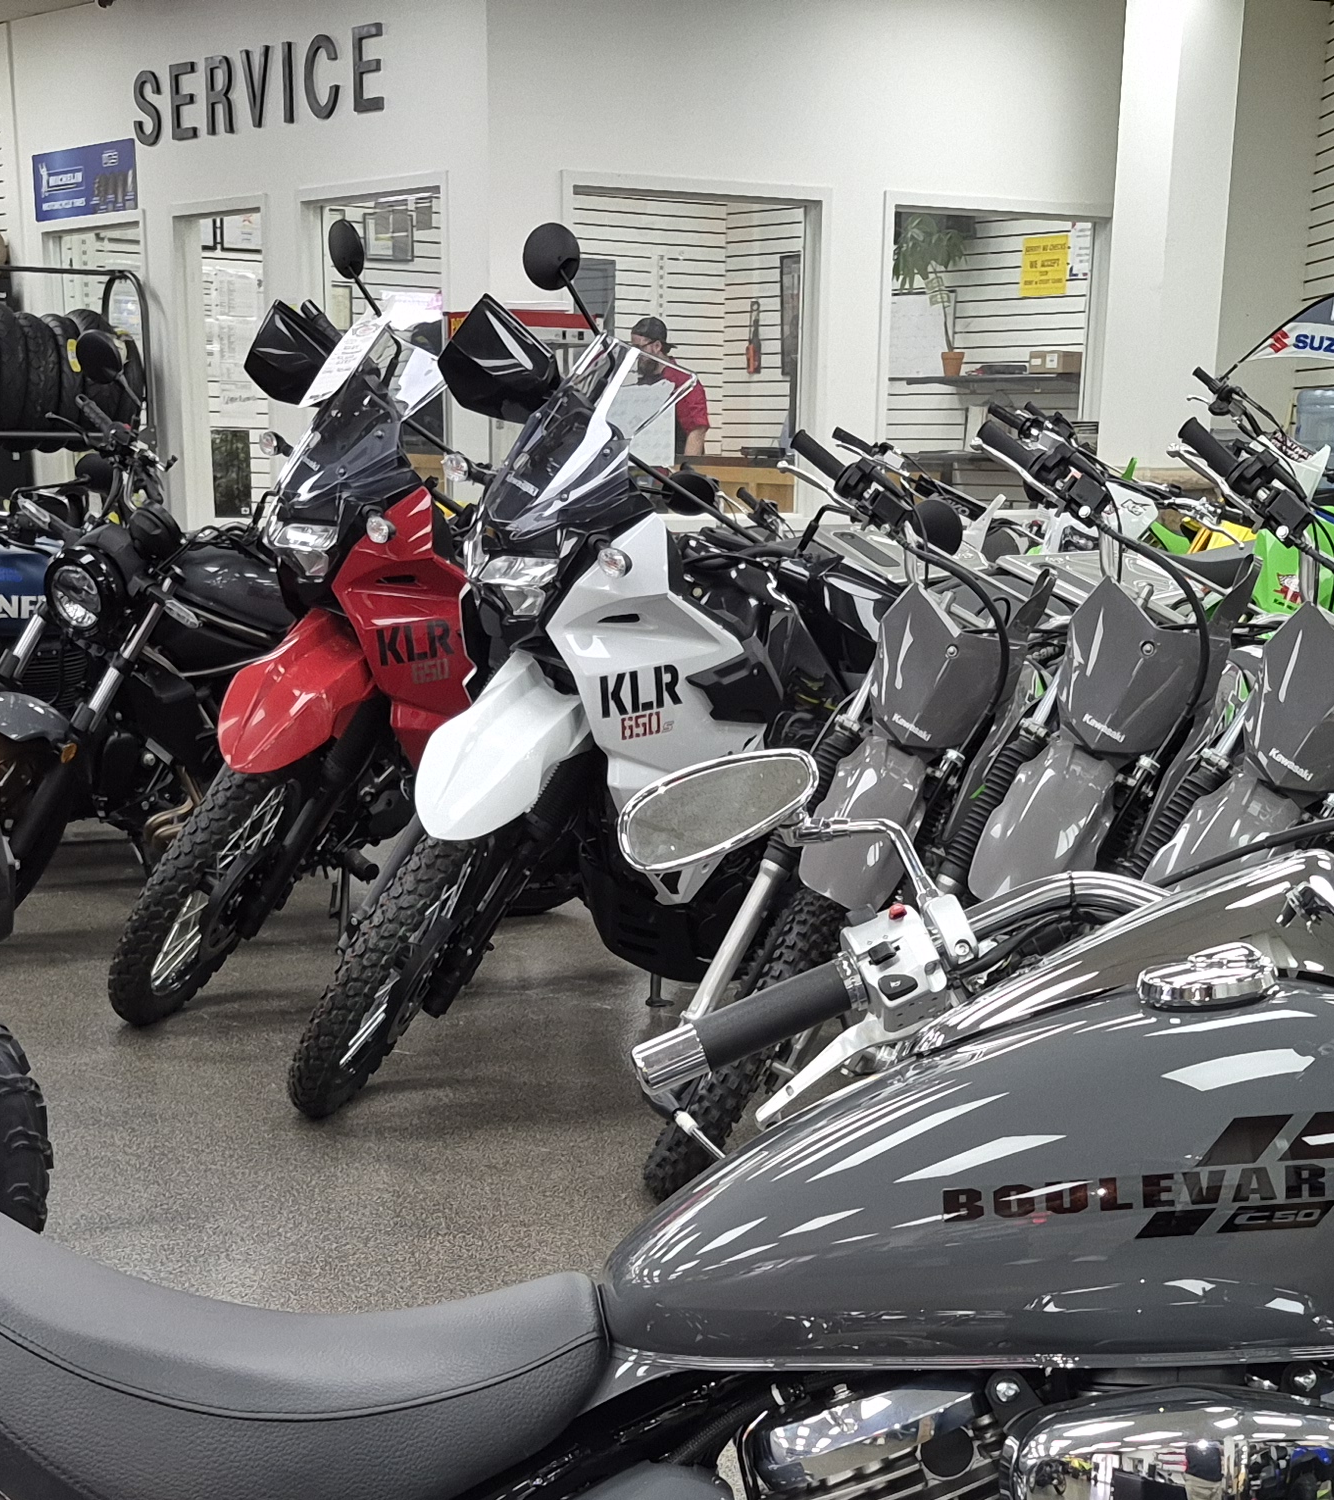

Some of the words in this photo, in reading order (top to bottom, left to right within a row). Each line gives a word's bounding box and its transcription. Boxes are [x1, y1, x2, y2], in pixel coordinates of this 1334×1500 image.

[133, 22, 385, 147] SERVICE
[375, 619, 454, 667] KLR
[411, 658, 450, 685] 650
[598, 664, 683, 719] KLR
[891, 712, 932, 742] Kawasaki
[1082, 712, 1126, 743] Kawasaki
[1268, 748, 1314, 782] Kawasaki
[1233, 1207, 1322, 1227] C50
